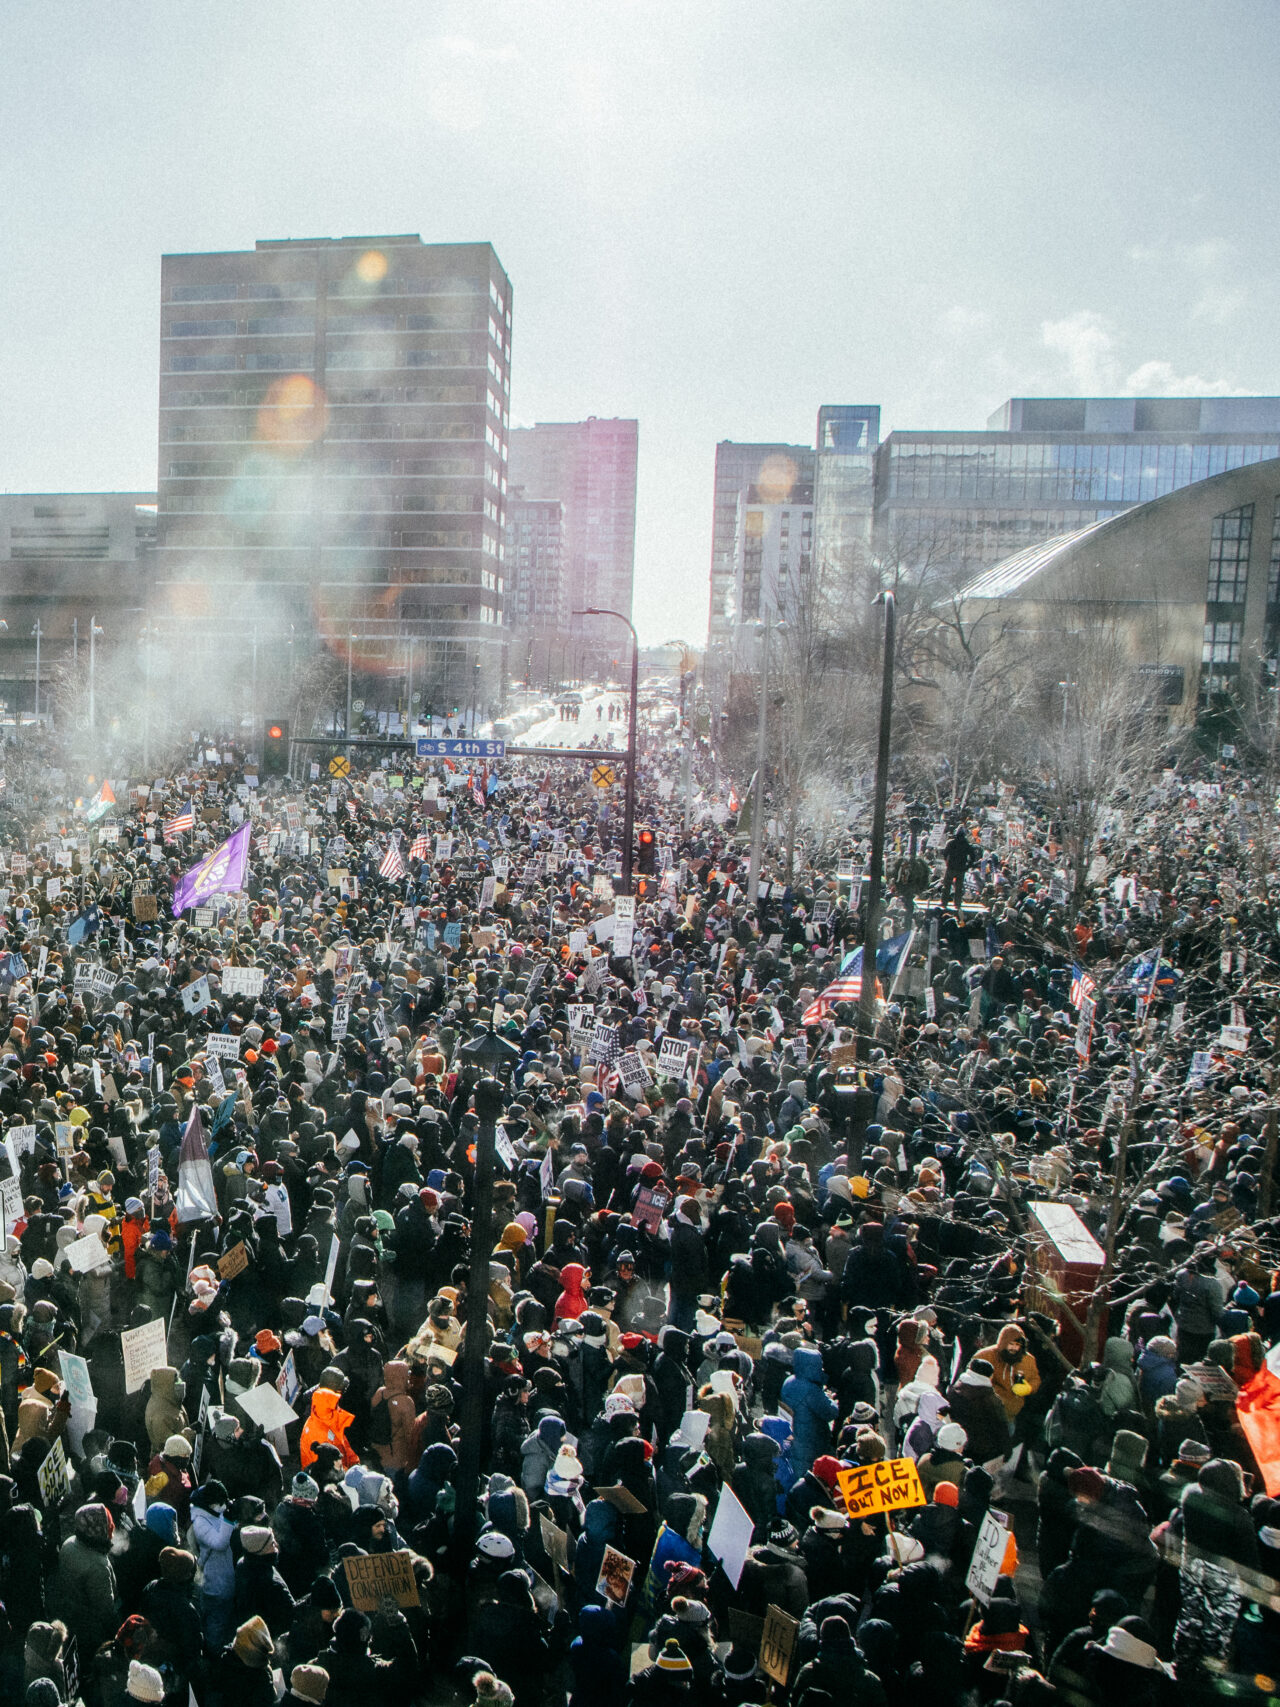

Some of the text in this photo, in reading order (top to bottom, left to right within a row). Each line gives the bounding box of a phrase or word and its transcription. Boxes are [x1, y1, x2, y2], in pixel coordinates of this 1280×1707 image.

[438, 743, 502, 754] S 4th St
[79, 964, 90, 974] ICE
[95, 967, 117, 985] STOP
[222, 968, 263, 980] BILL OF
[222, 982, 264, 993] RIGHTS
[336, 1005, 345, 1022] ICE
[580, 1014, 597, 1030] ICE
[211, 1036, 238, 1044] DISSENT
[595, 1025, 613, 1043] STOP
[207, 1050, 238, 1058] PATRIOTIC
[662, 1040, 688, 1057] STOP
[619, 1056, 641, 1068] JONATHAN
[658, 1063, 683, 1072] NOW!
[623, 1070, 647, 1082] MURDER
[638, 1190, 665, 1207] NO ICE
[125, 1329, 145, 1342] WHAT'S
[44, 1447, 58, 1480] ICE
[46, 1463, 59, 1498] OUT
[53, 1474, 66, 1500] NOW
[848, 1461, 910, 1496] ICE
[849, 1478, 920, 1512] OUT NOW!
[347, 1554, 400, 1581] DEFEND
[768, 1618, 789, 1655] ICE
[762, 1641, 787, 1676] OUT
